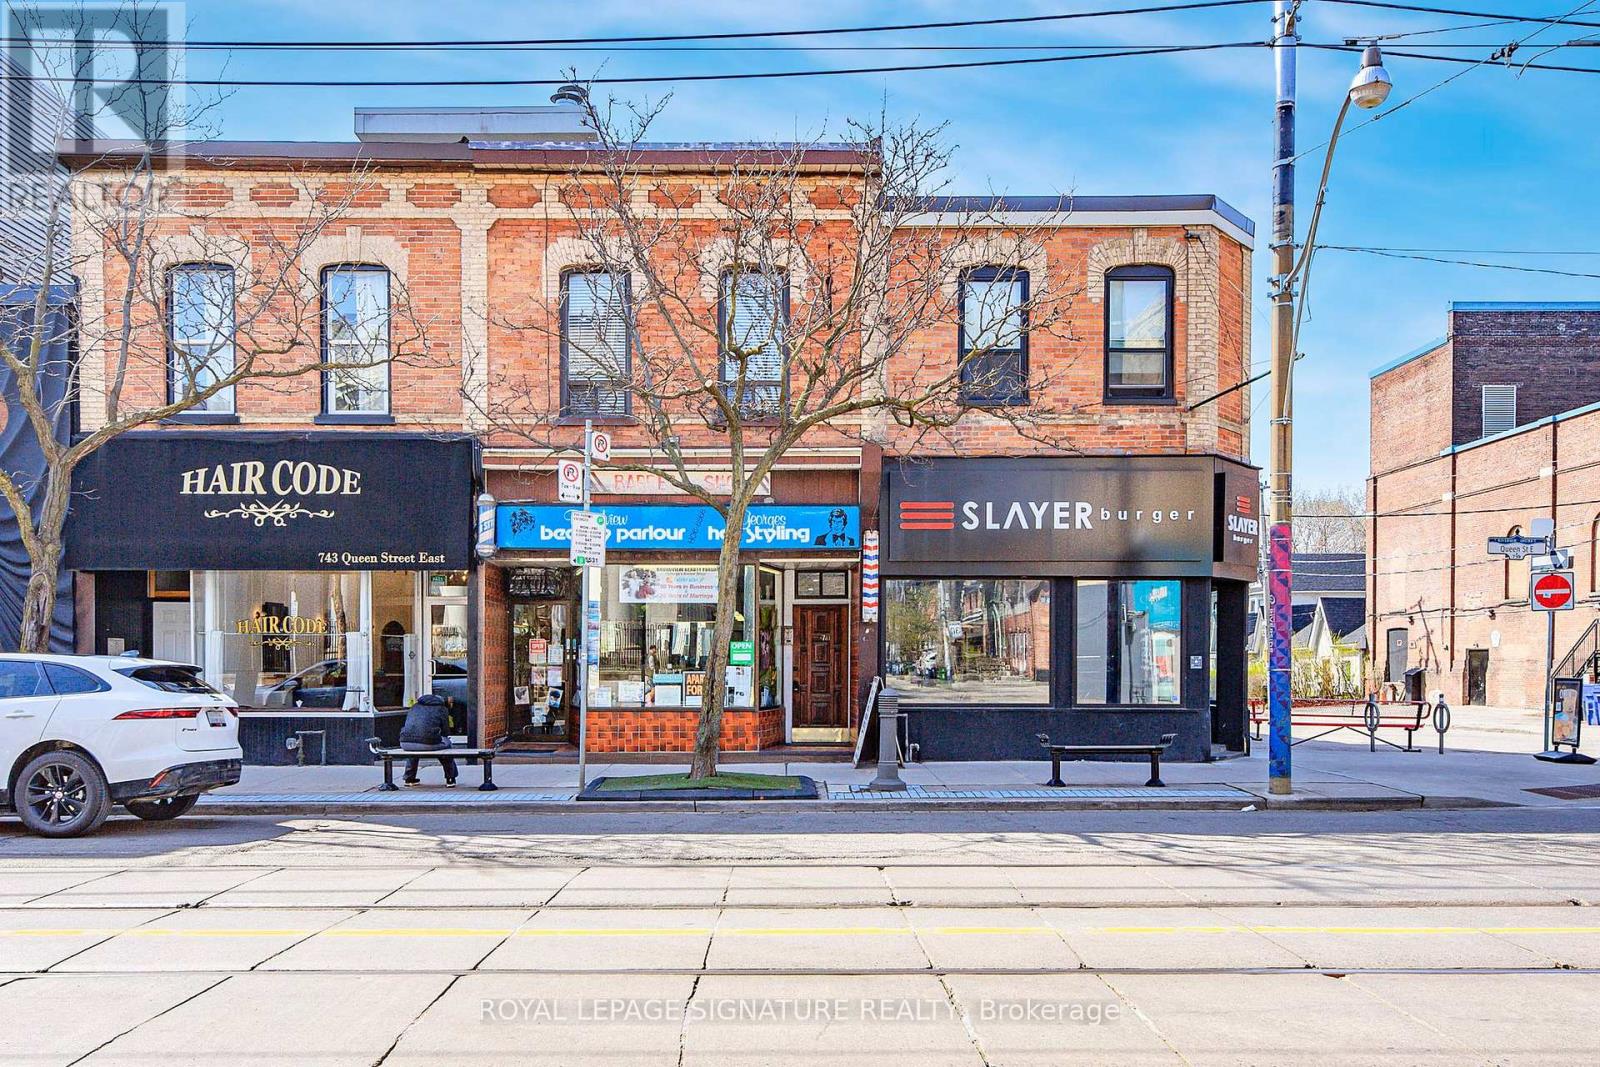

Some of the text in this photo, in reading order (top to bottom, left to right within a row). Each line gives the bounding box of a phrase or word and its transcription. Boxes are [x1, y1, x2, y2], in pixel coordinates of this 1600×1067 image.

[180, 460, 361, 496] HAIR CODE
[961, 501, 1195, 531] SLAYER burger
[1228, 514, 1258, 536] SLAYER
[616, 524, 686, 543] parlour
[1500, 545, 1520, 553] Queen
[318, 552, 446, 566] 743 Queen Street East
[237, 616, 328, 634] HAIR CODE
[686, 685, 703, 695] FOR
